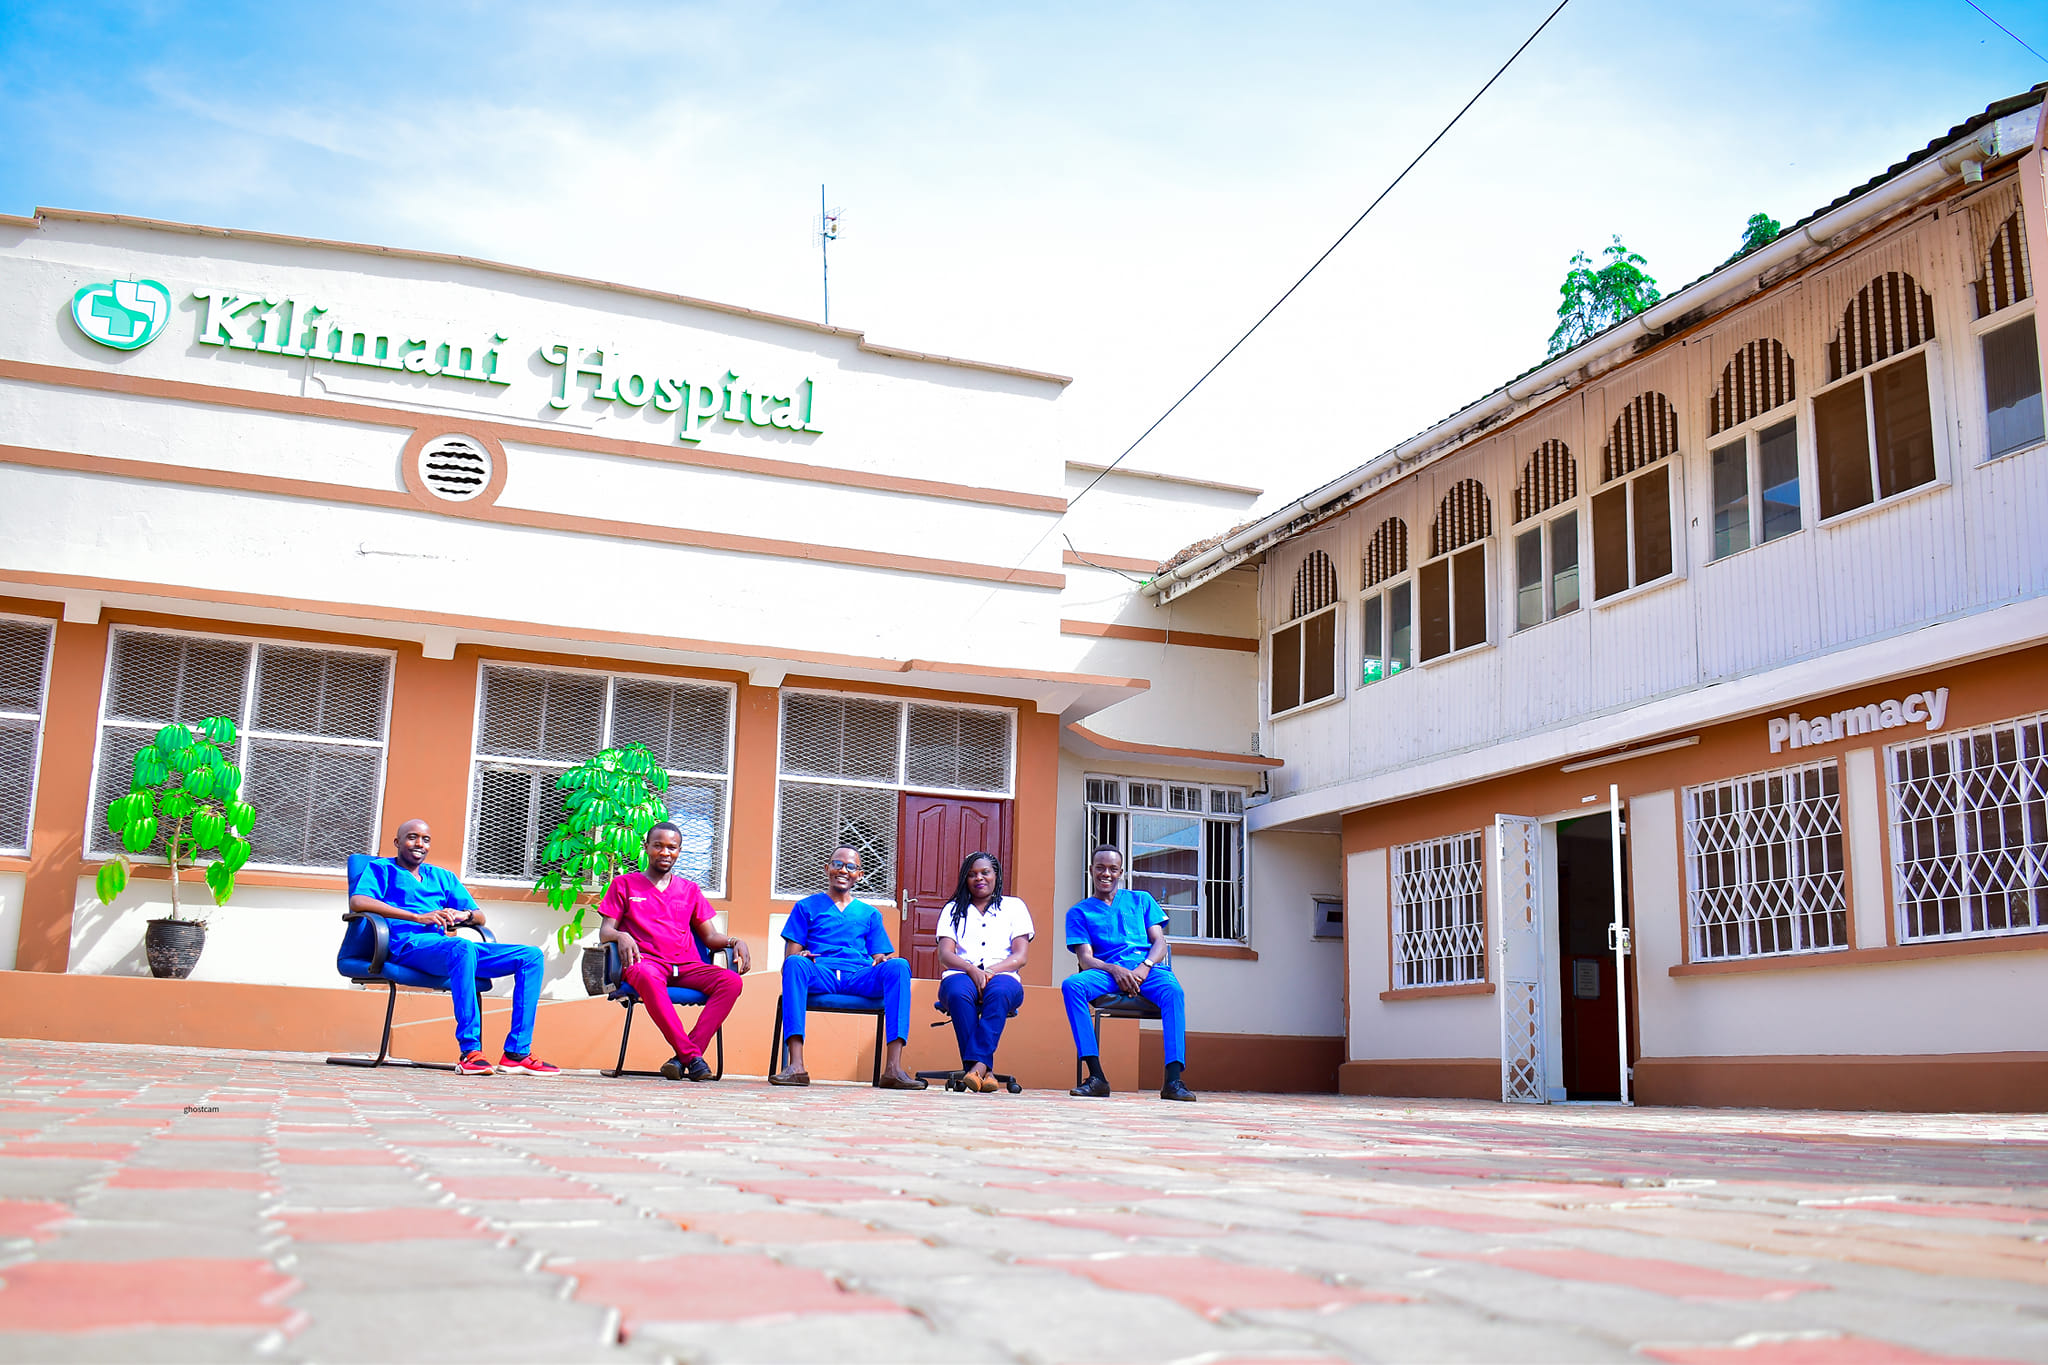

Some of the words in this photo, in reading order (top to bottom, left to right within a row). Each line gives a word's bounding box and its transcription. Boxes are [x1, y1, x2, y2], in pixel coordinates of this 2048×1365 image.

[192, 287, 511, 386] Kilimani
[539, 342, 823, 443] Hospital
[1768, 687, 1949, 753] Pharmacy
